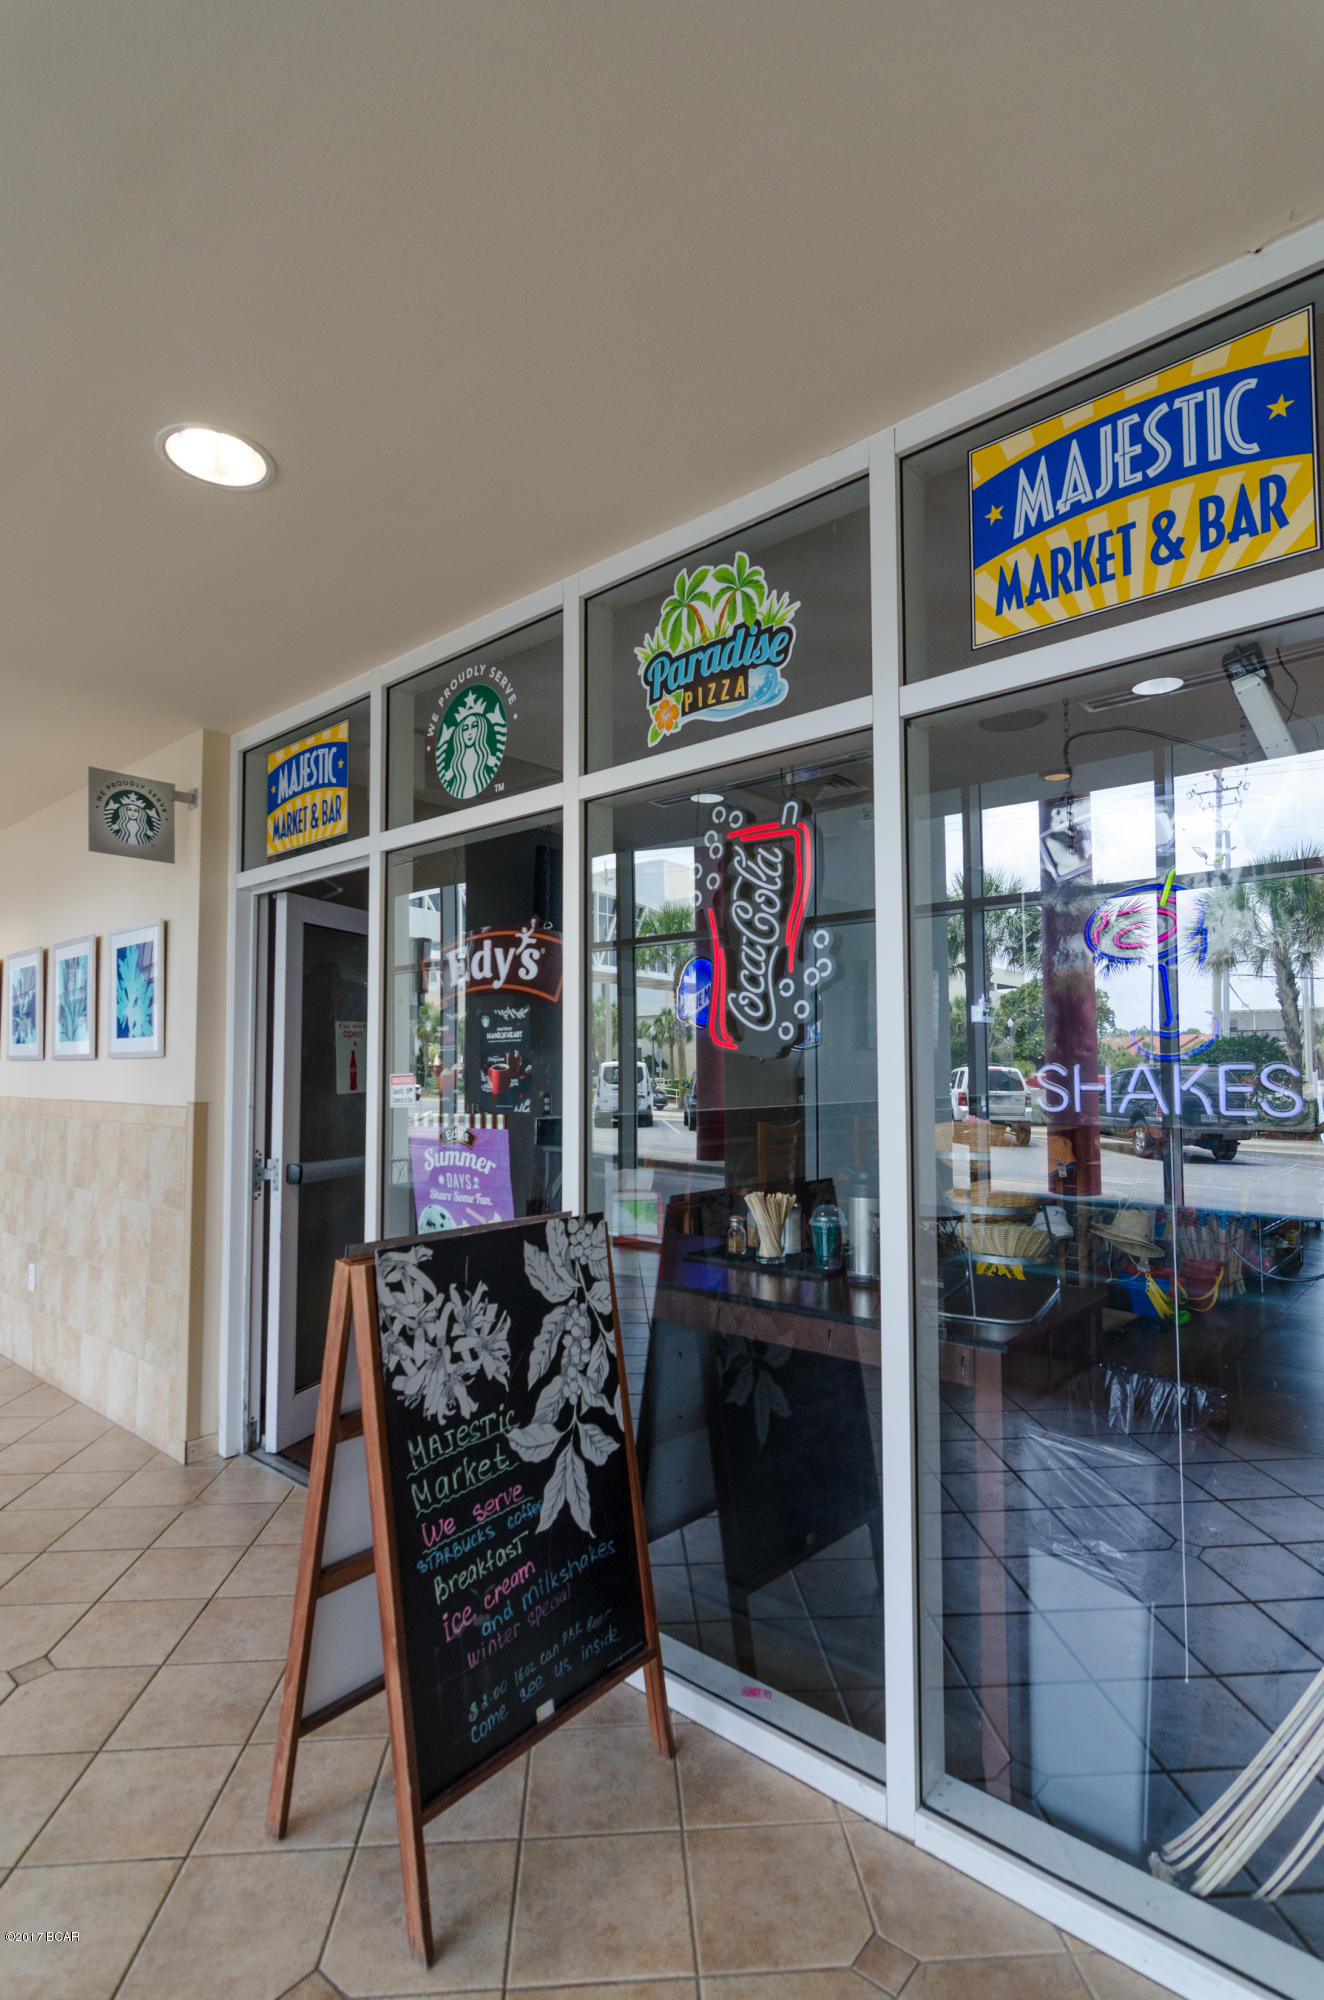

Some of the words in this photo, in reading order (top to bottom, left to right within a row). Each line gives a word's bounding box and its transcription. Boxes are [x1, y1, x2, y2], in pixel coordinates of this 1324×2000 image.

[1013, 377, 1260, 540] MAJESTIC
[995, 521, 1137, 616] MARKET
[1150, 509, 1185, 566] &
[1199, 473, 1290, 553] BAR
[647, 624, 790, 699] Paradise
[426, 711, 439, 737] WE
[438, 664, 487, 708] PROUDLY
[488, 666, 517, 705] SERVE
[684, 675, 745, 712] PIZZA
[106, 780, 146, 790] PROUDLY
[148, 789, 168, 812] SERVE
[277, 747, 337, 804] MAJESTIC
[272, 806, 308, 842] MARKET
[310, 808, 319, 829] &
[321, 794, 342, 825] BAR
[1036, 1063, 1304, 1118] SHAKES
[424, 1148, 496, 1174] Summer
[446, 1172, 472, 1190] DAYS
[422, 1517, 457, 1547] We
[482, 1600, 513, 1636] and
[521, 1539, 616, 1611] milkshakes
[483, 1561, 536, 1610] cream
[466, 1622, 520, 1669] winter
